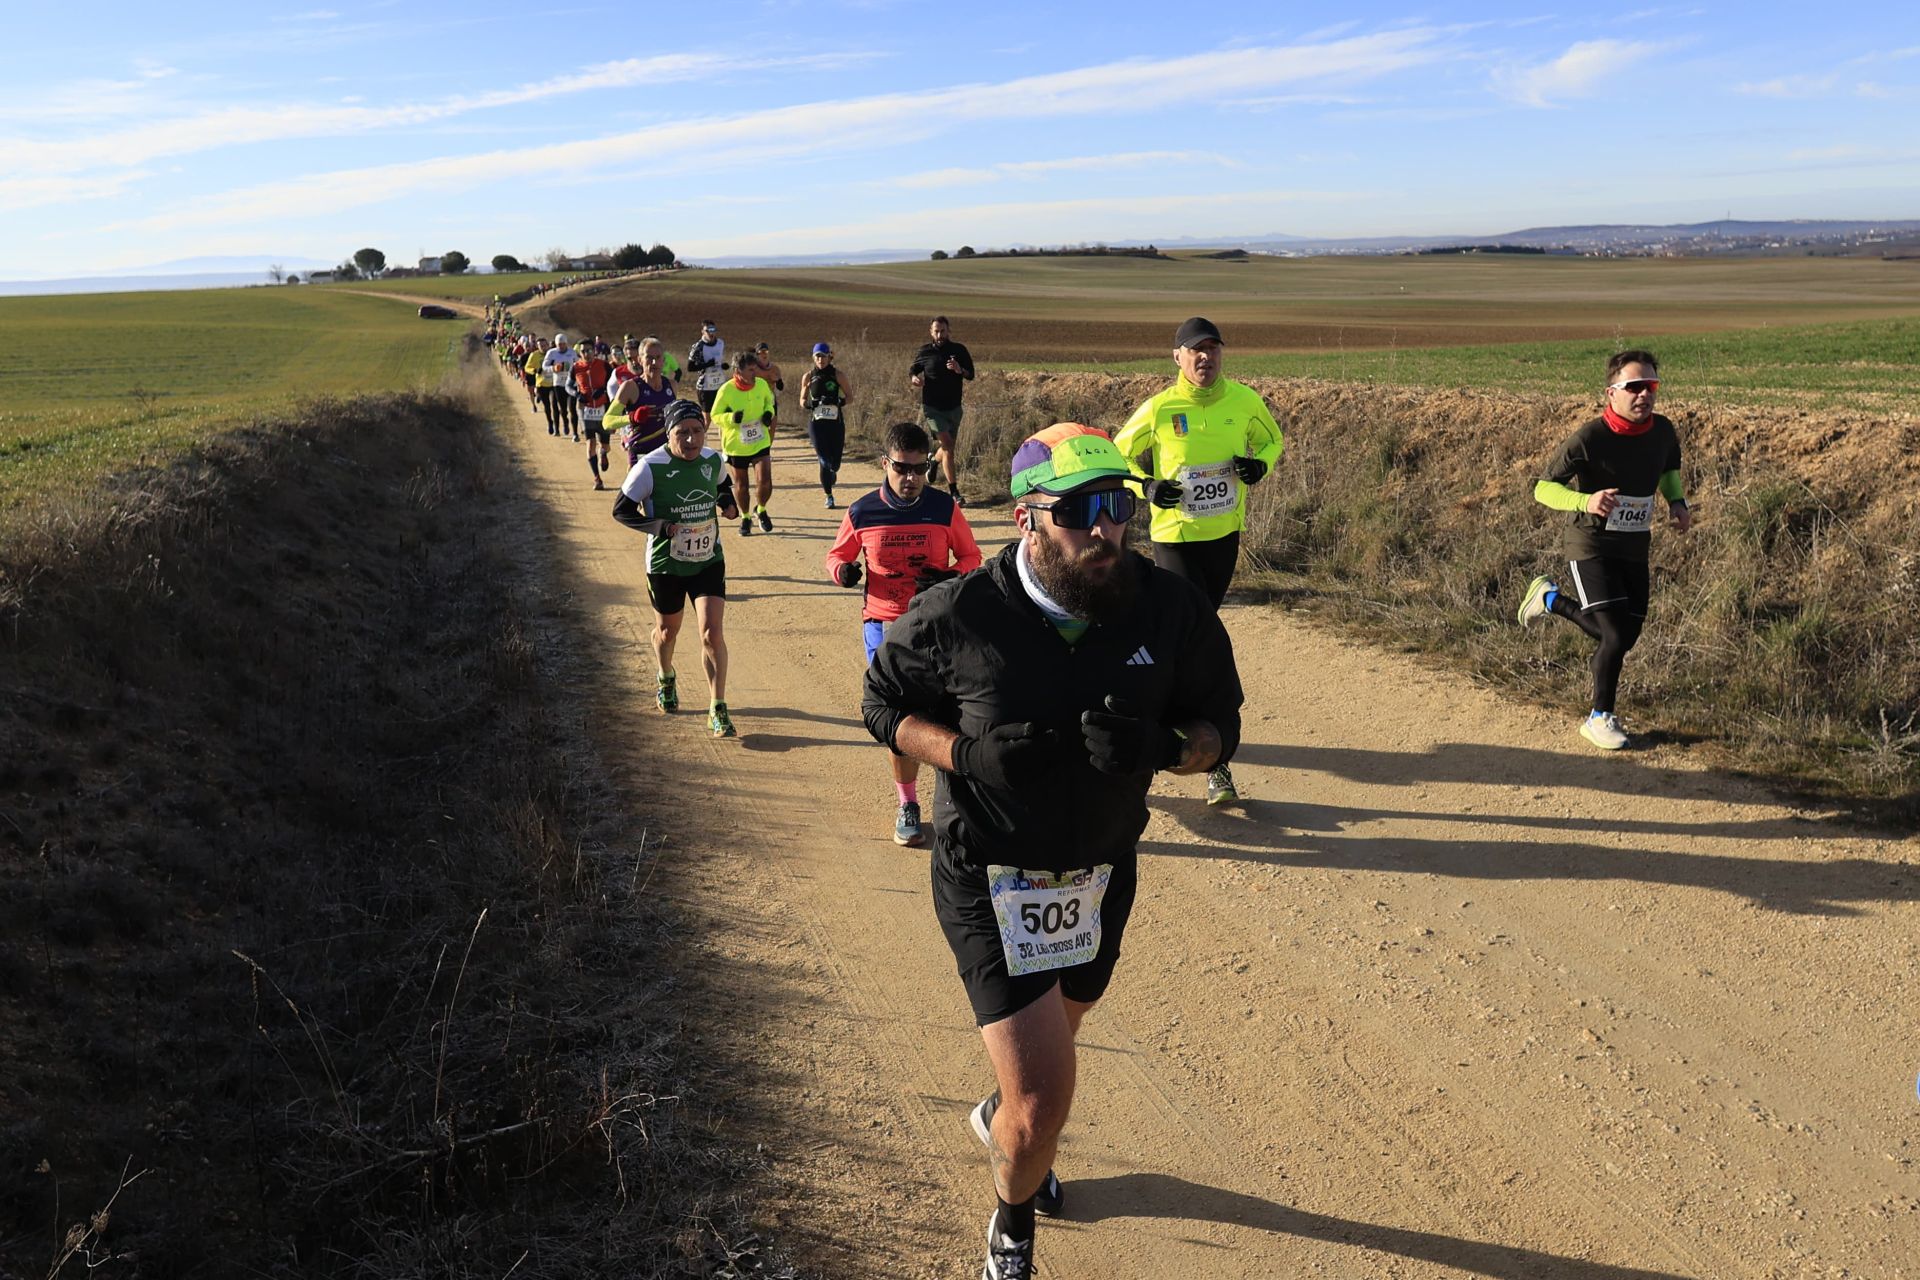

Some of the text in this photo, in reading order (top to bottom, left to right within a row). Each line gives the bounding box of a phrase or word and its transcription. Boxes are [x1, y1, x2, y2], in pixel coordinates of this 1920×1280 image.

[746, 428, 758, 438] 85
[1193, 481, 1228, 501] 299
[1187, 503, 1197, 512] 32
[1618, 509, 1647, 522] 1045
[684, 536, 710, 551] 119
[1057, 886, 1091, 897] REFORMAS
[1021, 898, 1081, 935] 503
[1017, 942, 1035, 960] 32
[1049, 939, 1073, 954] CROSS
[1075, 932, 1093, 950] AVS
